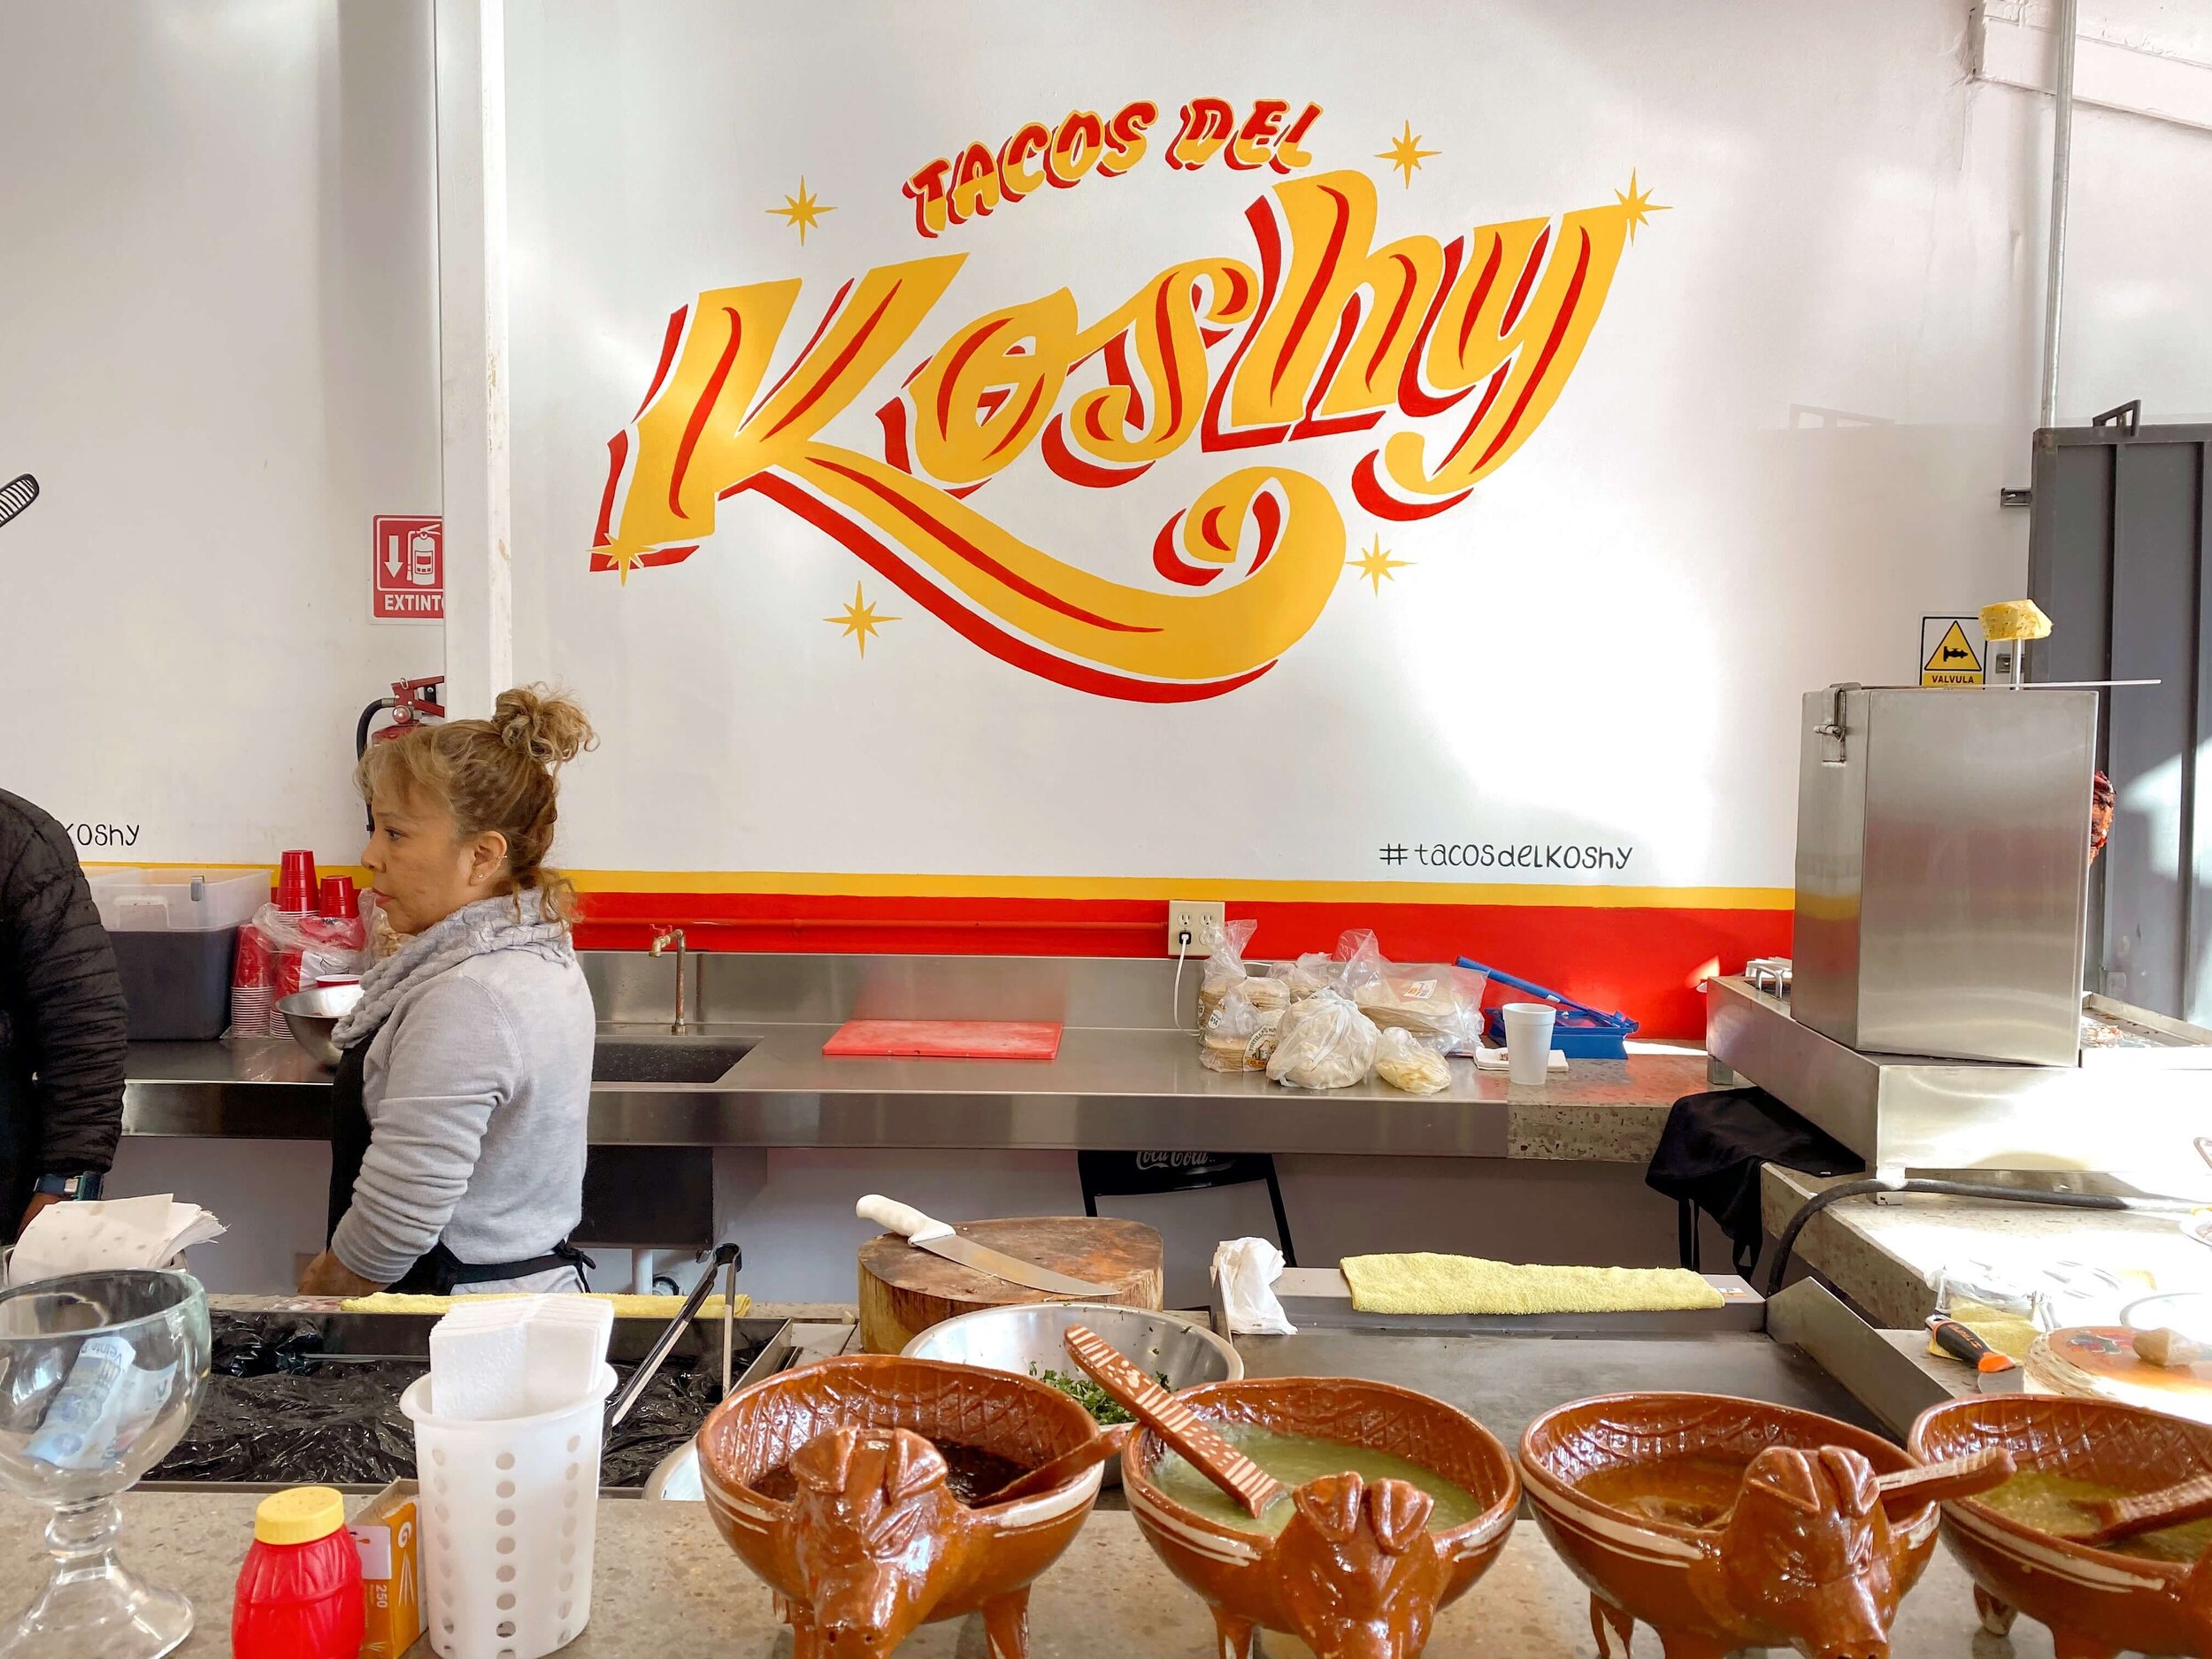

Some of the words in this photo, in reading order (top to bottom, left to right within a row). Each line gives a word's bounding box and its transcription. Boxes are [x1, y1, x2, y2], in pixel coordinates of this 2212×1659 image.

[902, 100, 1159, 239] TACOS
[1165, 96, 1324, 174] DEL
[589, 169, 1629, 703] Koshy
[384, 594, 444, 611] EXTINT
[1932, 675, 1974, 684] VALVULA
[376, 1585, 388, 1609] 250
